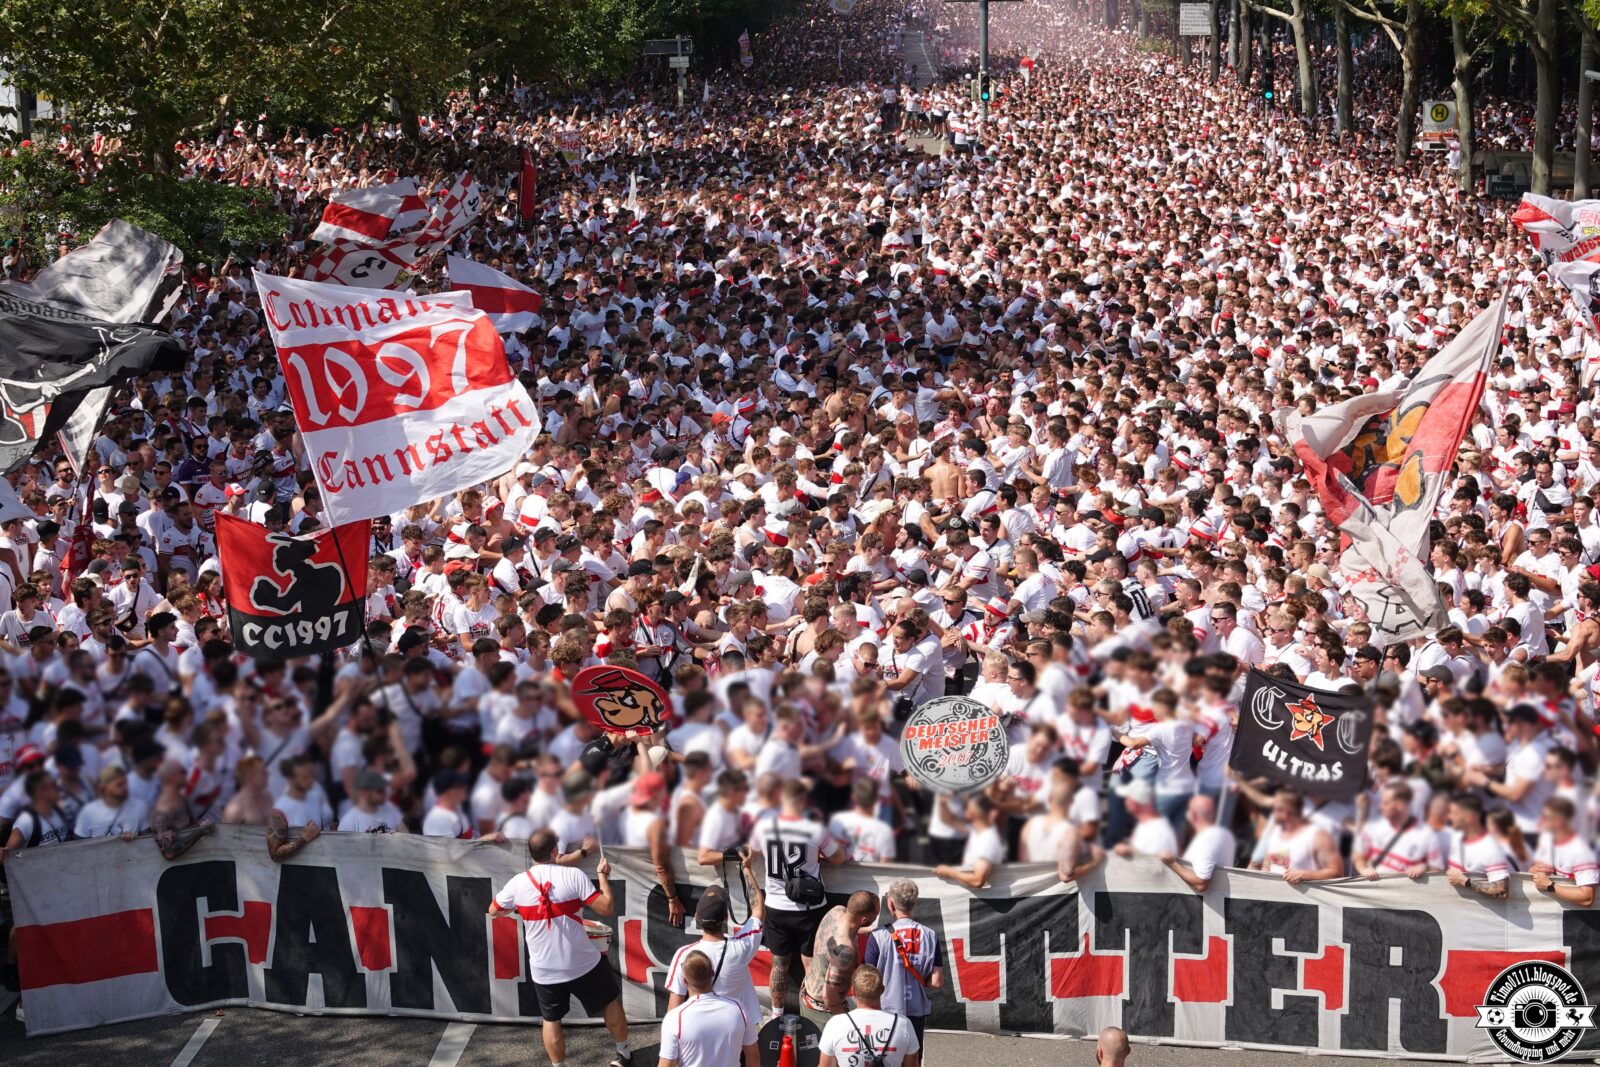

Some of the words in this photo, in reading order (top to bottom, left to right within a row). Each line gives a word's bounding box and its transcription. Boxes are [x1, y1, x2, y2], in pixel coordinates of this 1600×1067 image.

[265, 289, 454, 332] Comman
[288, 319, 476, 426] 1997
[317, 398, 532, 493] Cannstatt
[242, 610, 349, 650] CC1997
[904, 715, 999, 741] DEUTSCHER
[918, 730, 990, 752] MEISTER
[1251, 686, 1287, 730] C
[1336, 709, 1367, 754] C
[1262, 740, 1344, 782] ULTRAS
